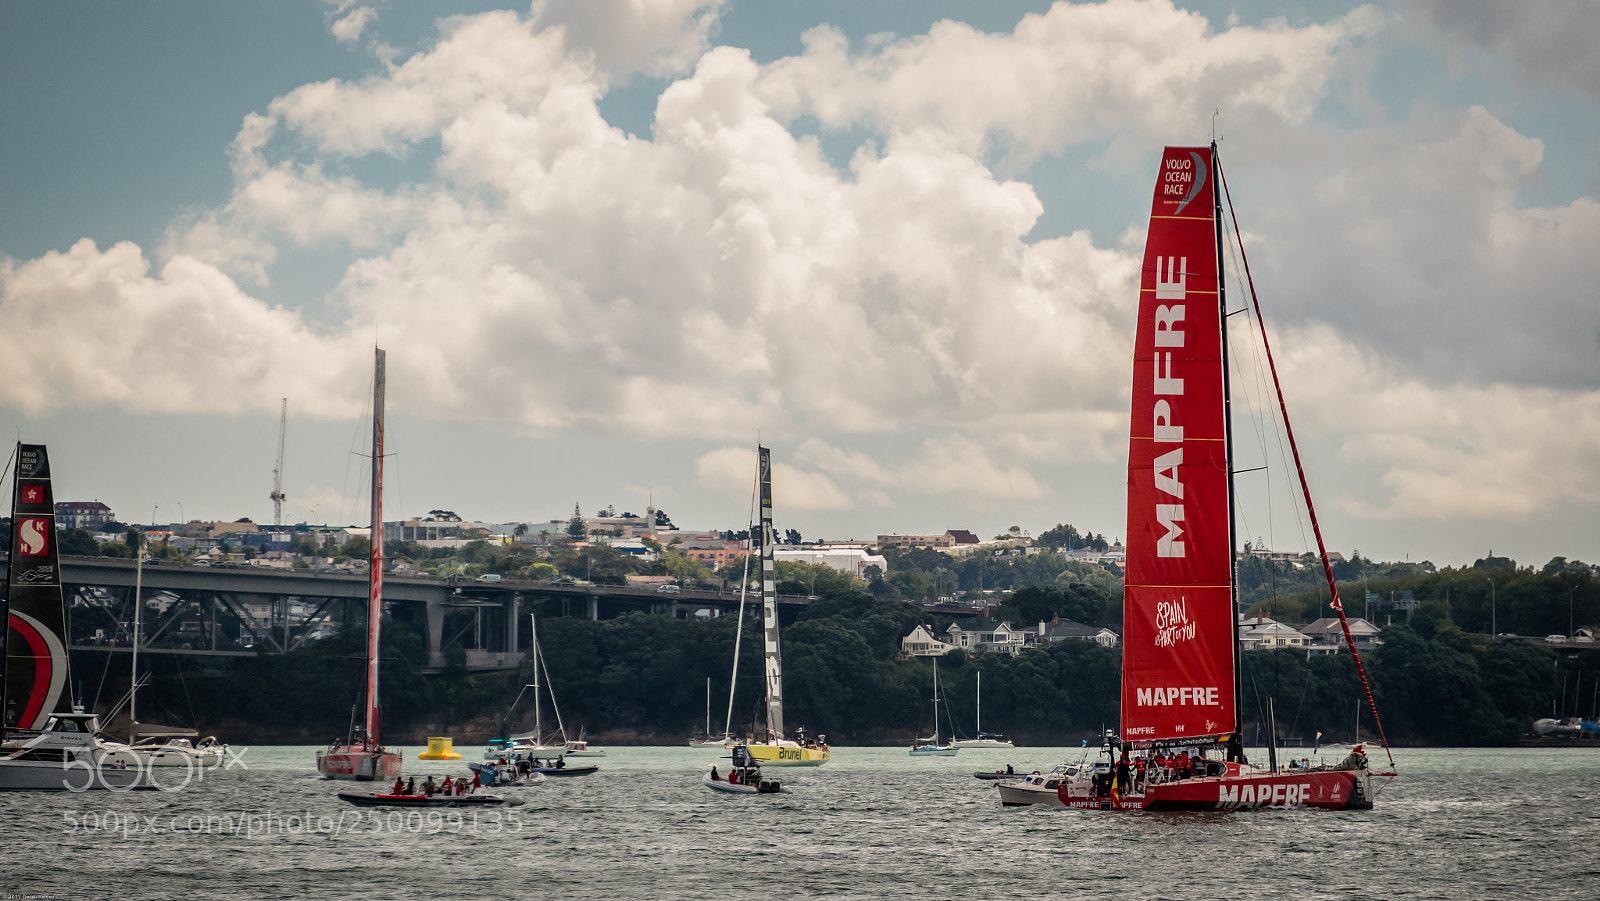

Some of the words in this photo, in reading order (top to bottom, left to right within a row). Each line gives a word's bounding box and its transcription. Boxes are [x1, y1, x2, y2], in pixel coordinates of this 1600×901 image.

[1166, 159, 1191, 170] VOLVO
[1165, 171, 1192, 182] OCEAN
[1164, 184, 1184, 195] RACE
[1153, 255, 1187, 558] MAPFRE
[1156, 596, 1188, 629] SPAIN
[1159, 626, 1178, 648] PART
[1181, 621, 1196, 642] YOU
[1136, 687, 1219, 707] MAPFRE
[1126, 726, 1155, 736] MAPFRE
[778, 747, 802, 761] Brunel
[1215, 783, 1310, 810] MAPFRE
